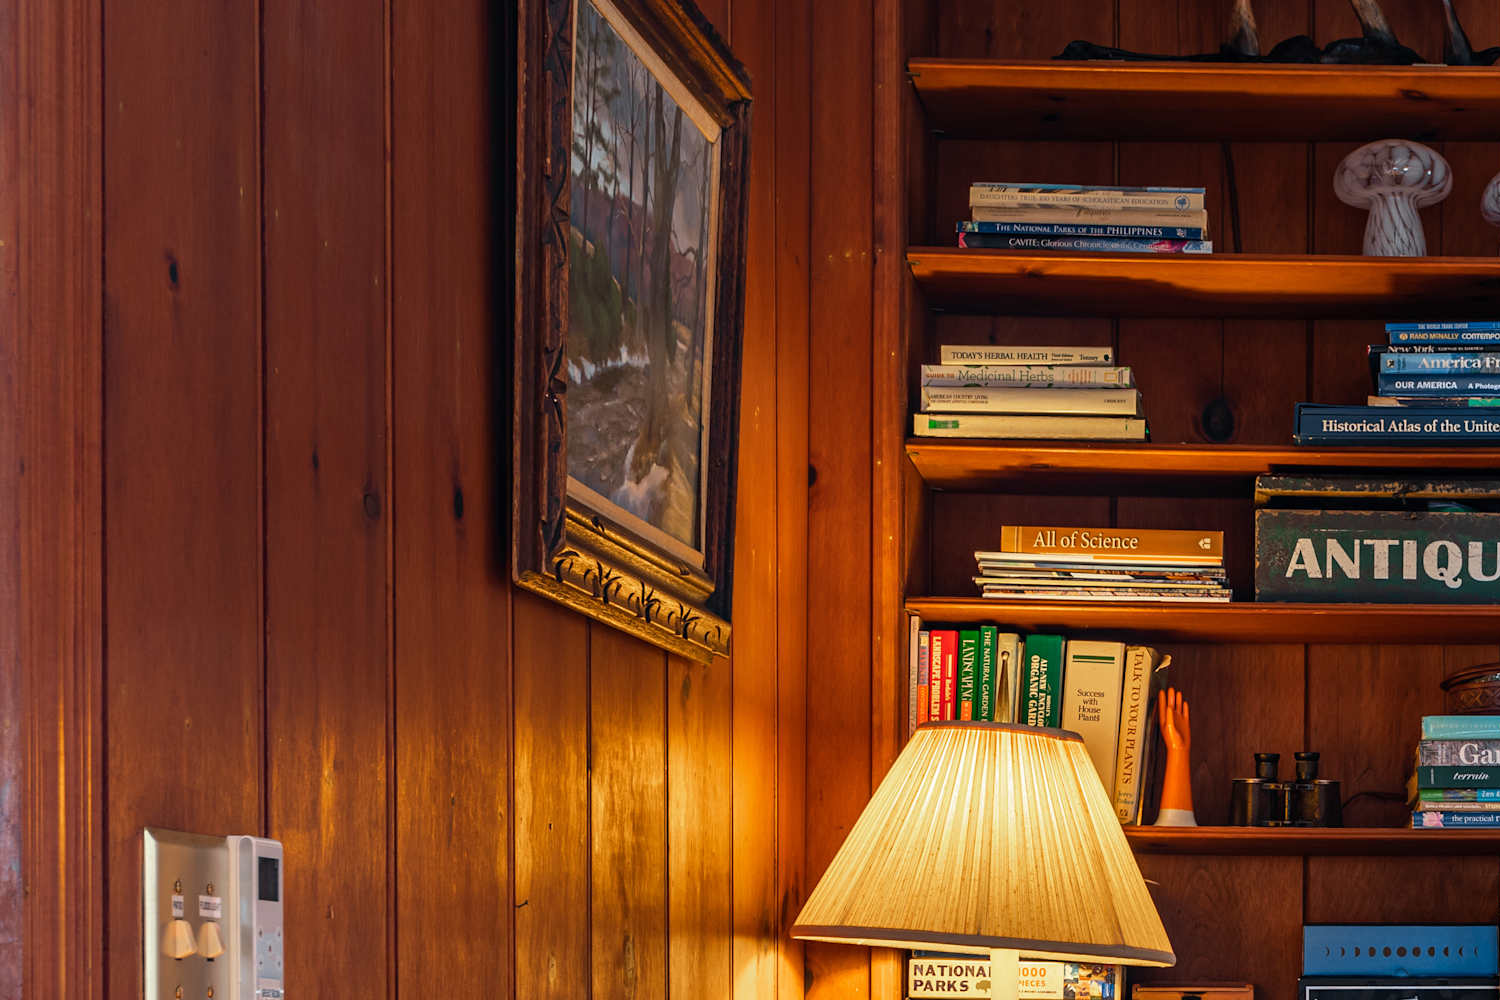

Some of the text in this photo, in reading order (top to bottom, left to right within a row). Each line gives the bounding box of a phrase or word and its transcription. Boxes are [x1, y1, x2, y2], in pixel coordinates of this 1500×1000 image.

[1106, 226, 1162, 236] PHILIPPINES
[952, 352, 982, 360] TODAY'S
[984, 352, 1015, 360] HERBAL
[1016, 352, 1048, 360] HEALTH
[1418, 357, 1481, 368] America
[958, 368, 1016, 382] Medicinal
[1019, 370, 1054, 382] Herbs
[1395, 381, 1414, 389] OUR
[1322, 419, 1385, 432] Historical
[1388, 420, 1421, 432] Atlas
[1424, 419, 1438, 432] of
[1441, 419, 1461, 432] the
[1034, 530, 1139, 550] All of Science
[982, 648, 990, 683] NATURAL
[1030, 655, 1040, 698] ORGANIC
[1077, 688, 1104, 698] Success
[982, 684, 990, 718] GARDEN
[1083, 698, 1098, 706] with
[1078, 706, 1101, 714] House
[1122, 652, 1144, 784] TALK TO YOUR PLANTS
[1453, 772, 1489, 781] terrain
[1452, 814, 1463, 823] the
[1464, 814, 1494, 825] practical
[913, 980, 969, 992] PARKS
